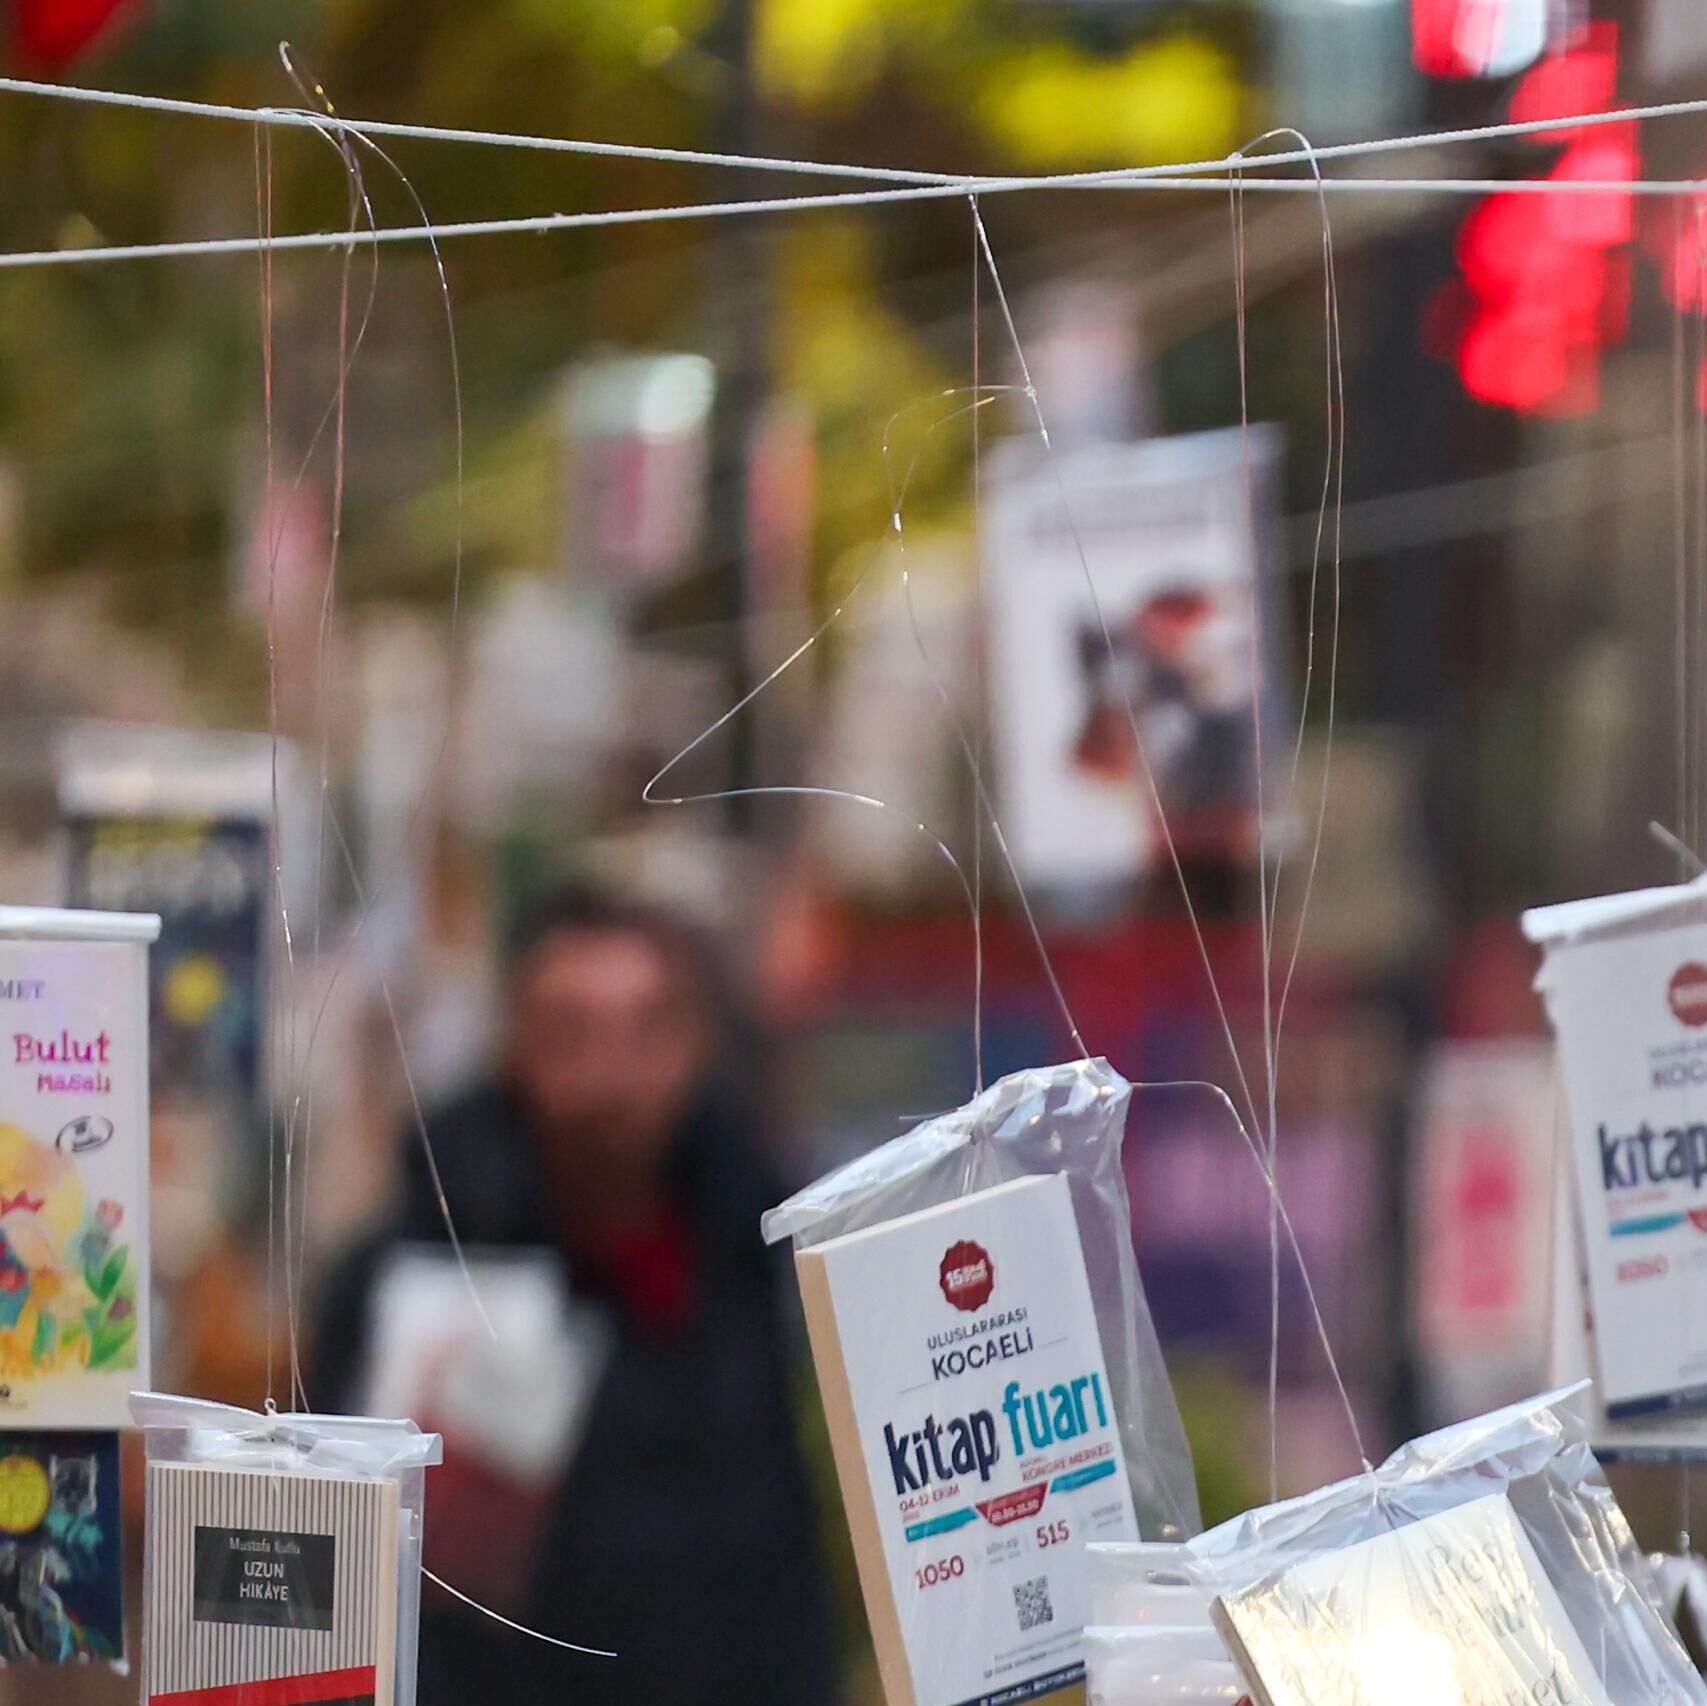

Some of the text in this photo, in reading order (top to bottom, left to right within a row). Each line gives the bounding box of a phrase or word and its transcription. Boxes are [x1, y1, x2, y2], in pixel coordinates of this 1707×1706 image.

[13, 1028, 111, 1064] Bulut
[927, 1307, 1028, 1350] ULUSLARARASI
[931, 1327, 1034, 1381] KOCAELİ
[884, 1371, 1108, 1495] kitap fuarı
[229, 1536, 271, 1552] Mustafa
[1036, 1519, 1070, 1548] 515
[244, 1560, 284, 1579] UZUN
[915, 1553, 965, 1590] 1050
